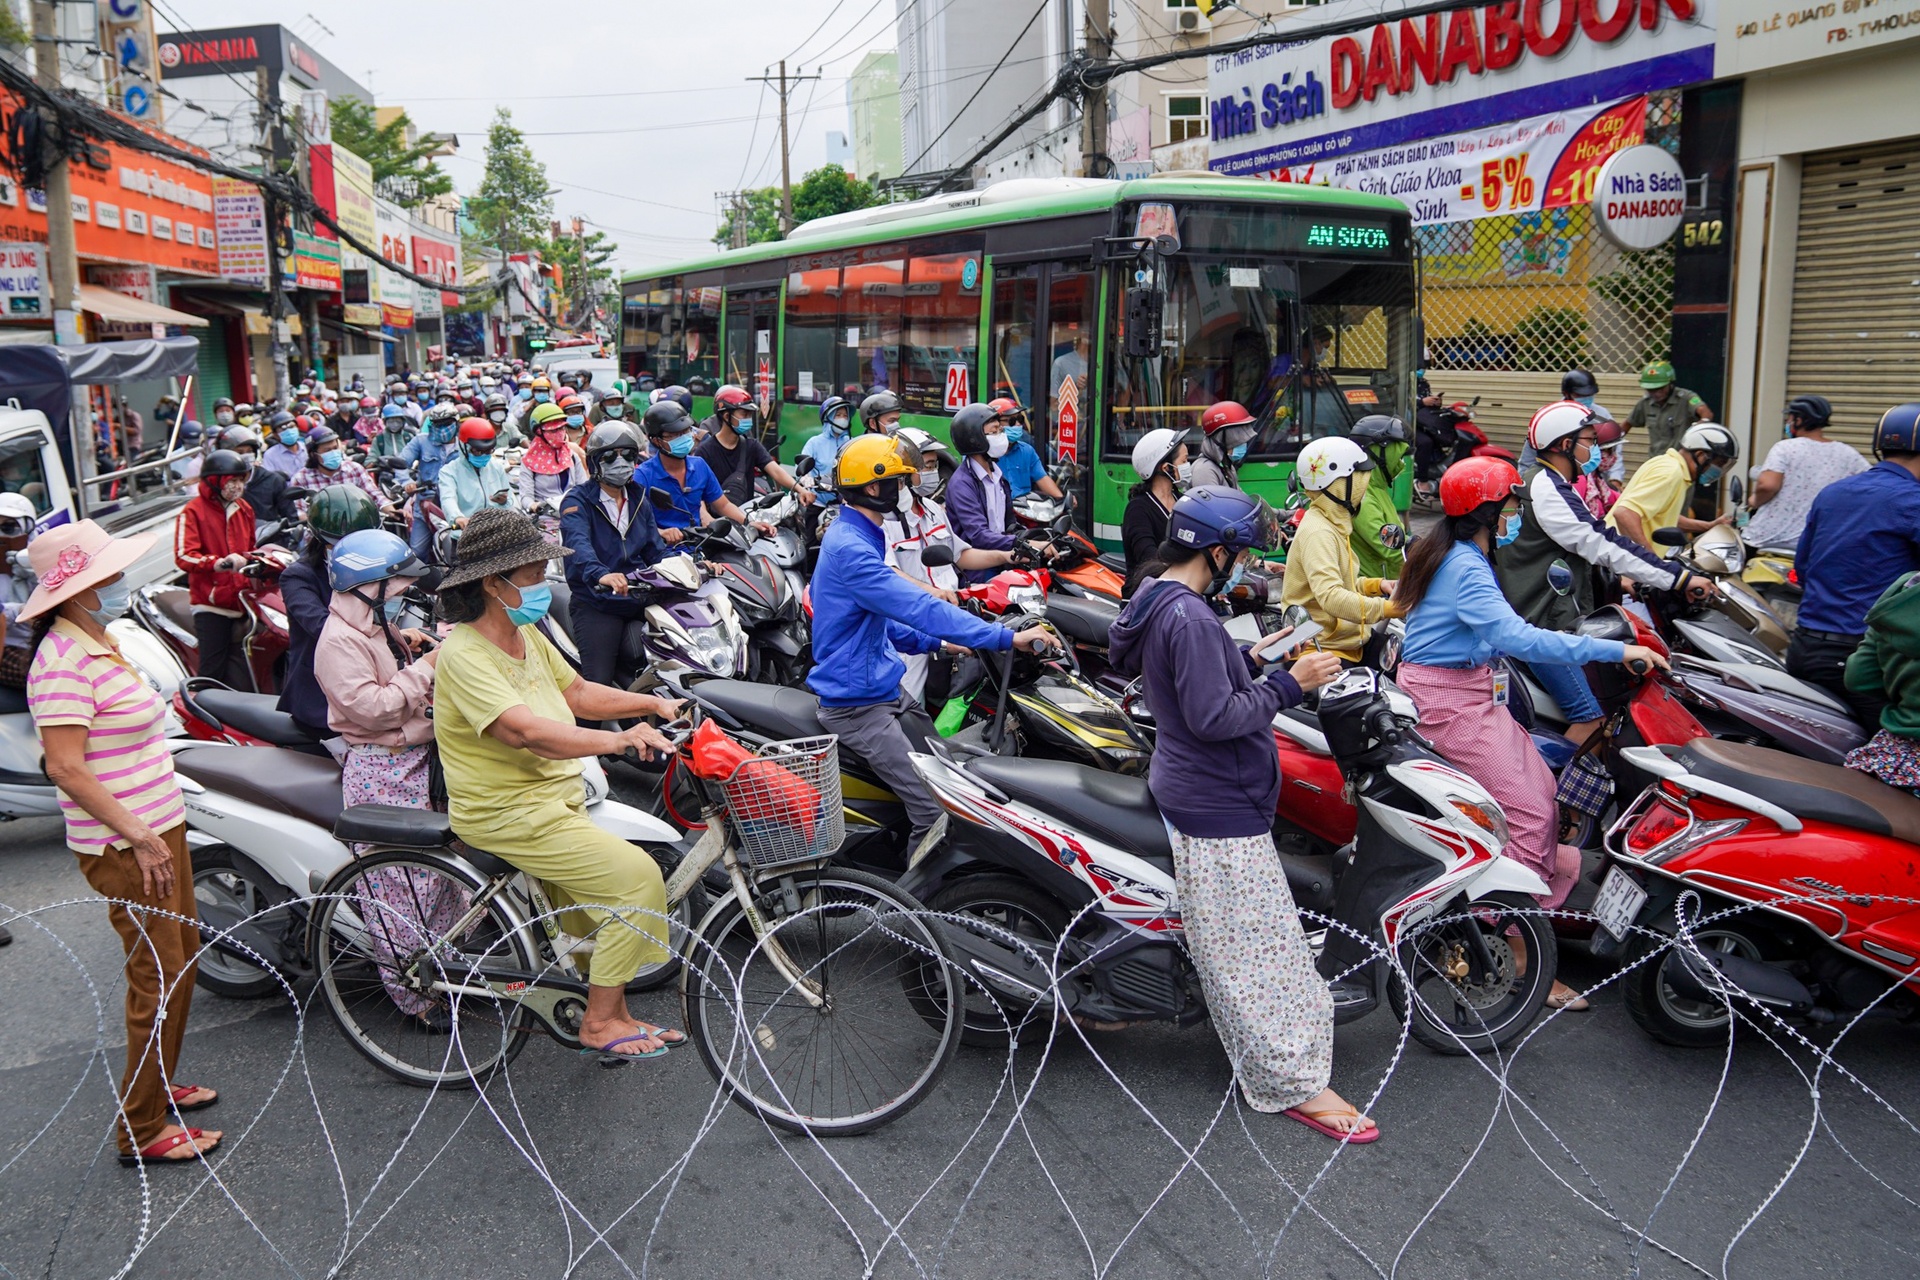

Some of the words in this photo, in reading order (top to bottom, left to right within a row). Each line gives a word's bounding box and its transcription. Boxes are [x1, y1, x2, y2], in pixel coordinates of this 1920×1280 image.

[1787, 3, 1836, 29] QUANG
[180, 36, 259, 65] YAMAHA
[1215, 54, 1230, 73] CTY
[1211, 87, 1257, 142] Nhà
[1260, 70, 1325, 129] Sách
[1593, 115, 1625, 137] Cặp
[1335, 157, 1357, 176] PHÁT
[1382, 148, 1404, 168] SÁCH
[1406, 143, 1428, 164] GIÁO
[1430, 139, 1455, 159] KHOA
[1574, 139, 1604, 162] Học
[1390, 171, 1420, 196] Giáo
[1426, 164, 1463, 190] Khoa
[1612, 172, 1645, 195] Nhà
[1649, 171, 1682, 193] Sách
[1413, 198, 1449, 222] Sinh
[1607, 197, 1684, 221] DANABOOK
[1307, 224, 1334, 246] AN
[1683, 219, 1723, 248] 542
[948, 367, 967, 407] 24
[506, 980, 526, 992] NEW
